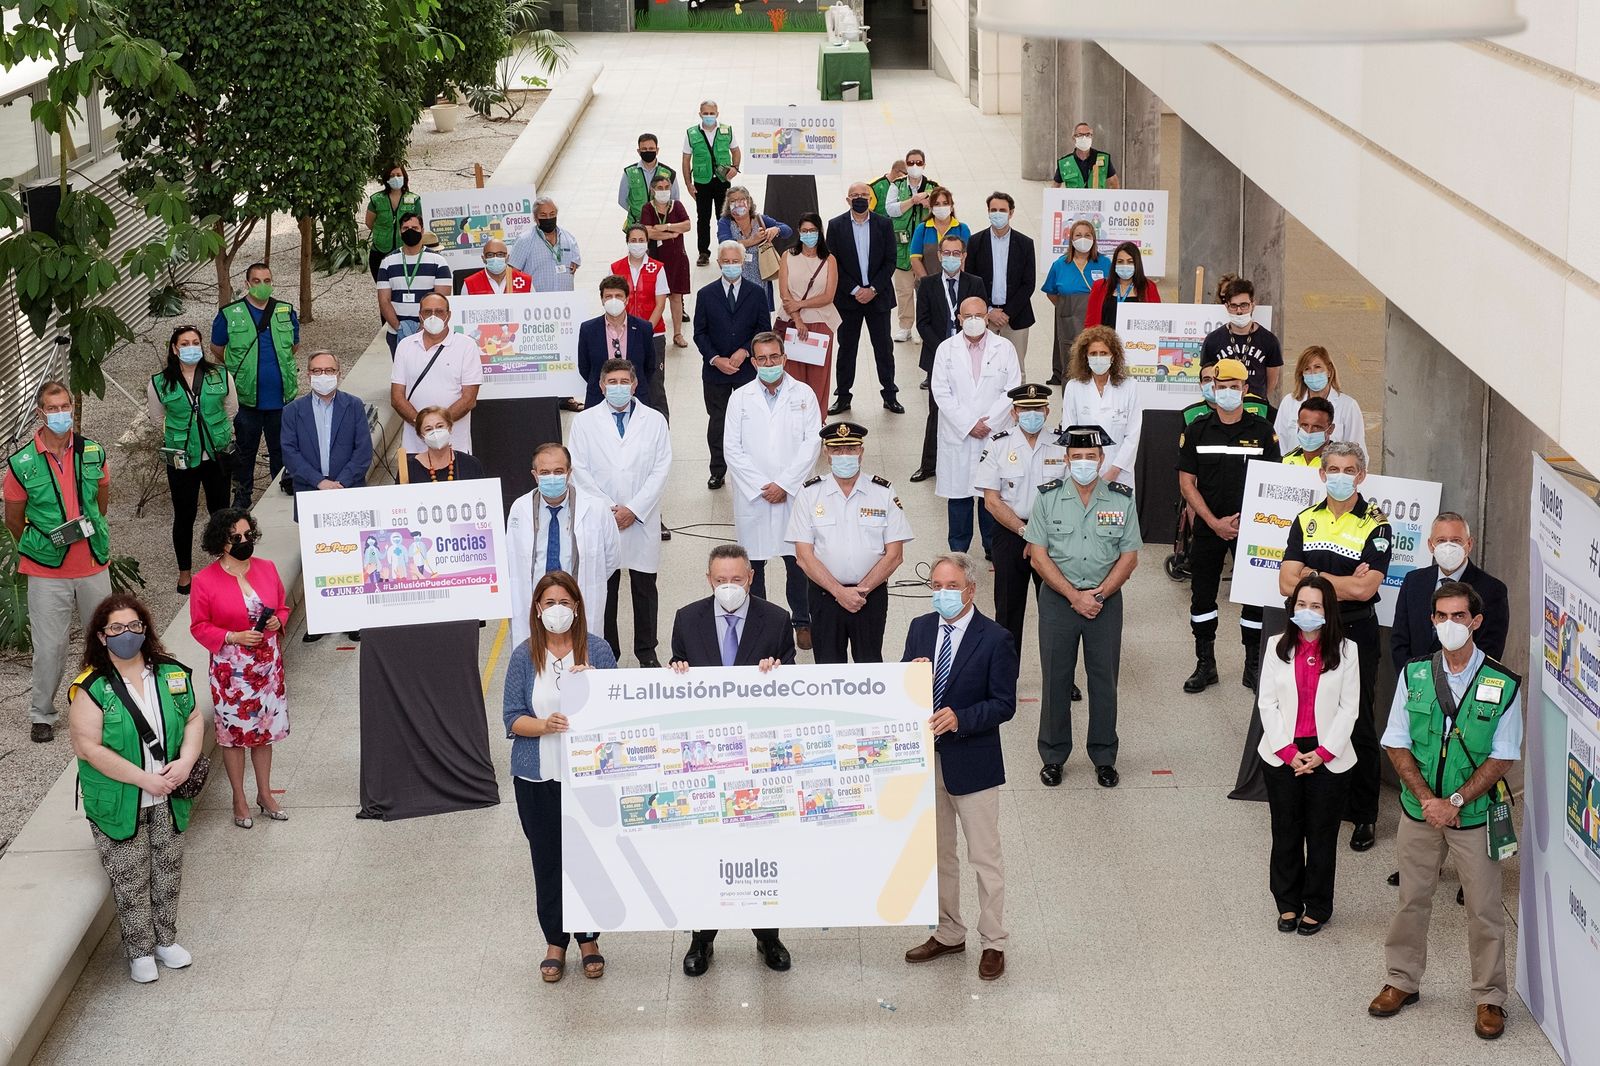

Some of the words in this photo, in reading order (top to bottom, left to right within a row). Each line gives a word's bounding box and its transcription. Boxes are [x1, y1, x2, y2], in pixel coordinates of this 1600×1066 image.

[485, 202, 521, 214] 00000
[1114, 201, 1154, 212] 00000
[506, 216, 530, 225] Gracias
[1109, 216, 1139, 226] Gracias
[524, 307, 571, 321] 00000
[522, 322, 555, 334] Gracias
[519, 343, 558, 352] pendientes
[1540, 476, 1563, 520] iguales
[417, 502, 486, 524] 00000
[392, 517, 408, 526] 000
[1254, 512, 1270, 523] La
[1269, 514, 1292, 528] Paga
[436, 534, 486, 552] Gracias
[1391, 532, 1414, 551] cias
[315, 543, 331, 554] La
[330, 542, 358, 554] Paga
[435, 554, 449, 565] por
[450, 553, 487, 563] cuidarnos
[329, 576, 360, 585] ONCE
[383, 577, 487, 590] #LaIlusiónPuedeConTodo
[608, 677, 886, 700] #LaIlusiónPuedeConTodo
[620, 728, 655, 739] 00000
[709, 726, 742, 738] 00000
[796, 724, 830, 736] 00000
[884, 722, 918, 734] 00000
[627, 745, 656, 755] Volvemos
[718, 742, 743, 752] Gracias
[806, 741, 832, 750] Gracias
[895, 742, 919, 751] Gracias
[672, 778, 706, 790] 00000
[763, 776, 792, 786] 00000
[840, 774, 870, 785] 00000
[692, 791, 715, 800] Gracias
[838, 787, 861, 796] Gracias
[720, 858, 778, 885] iguales
